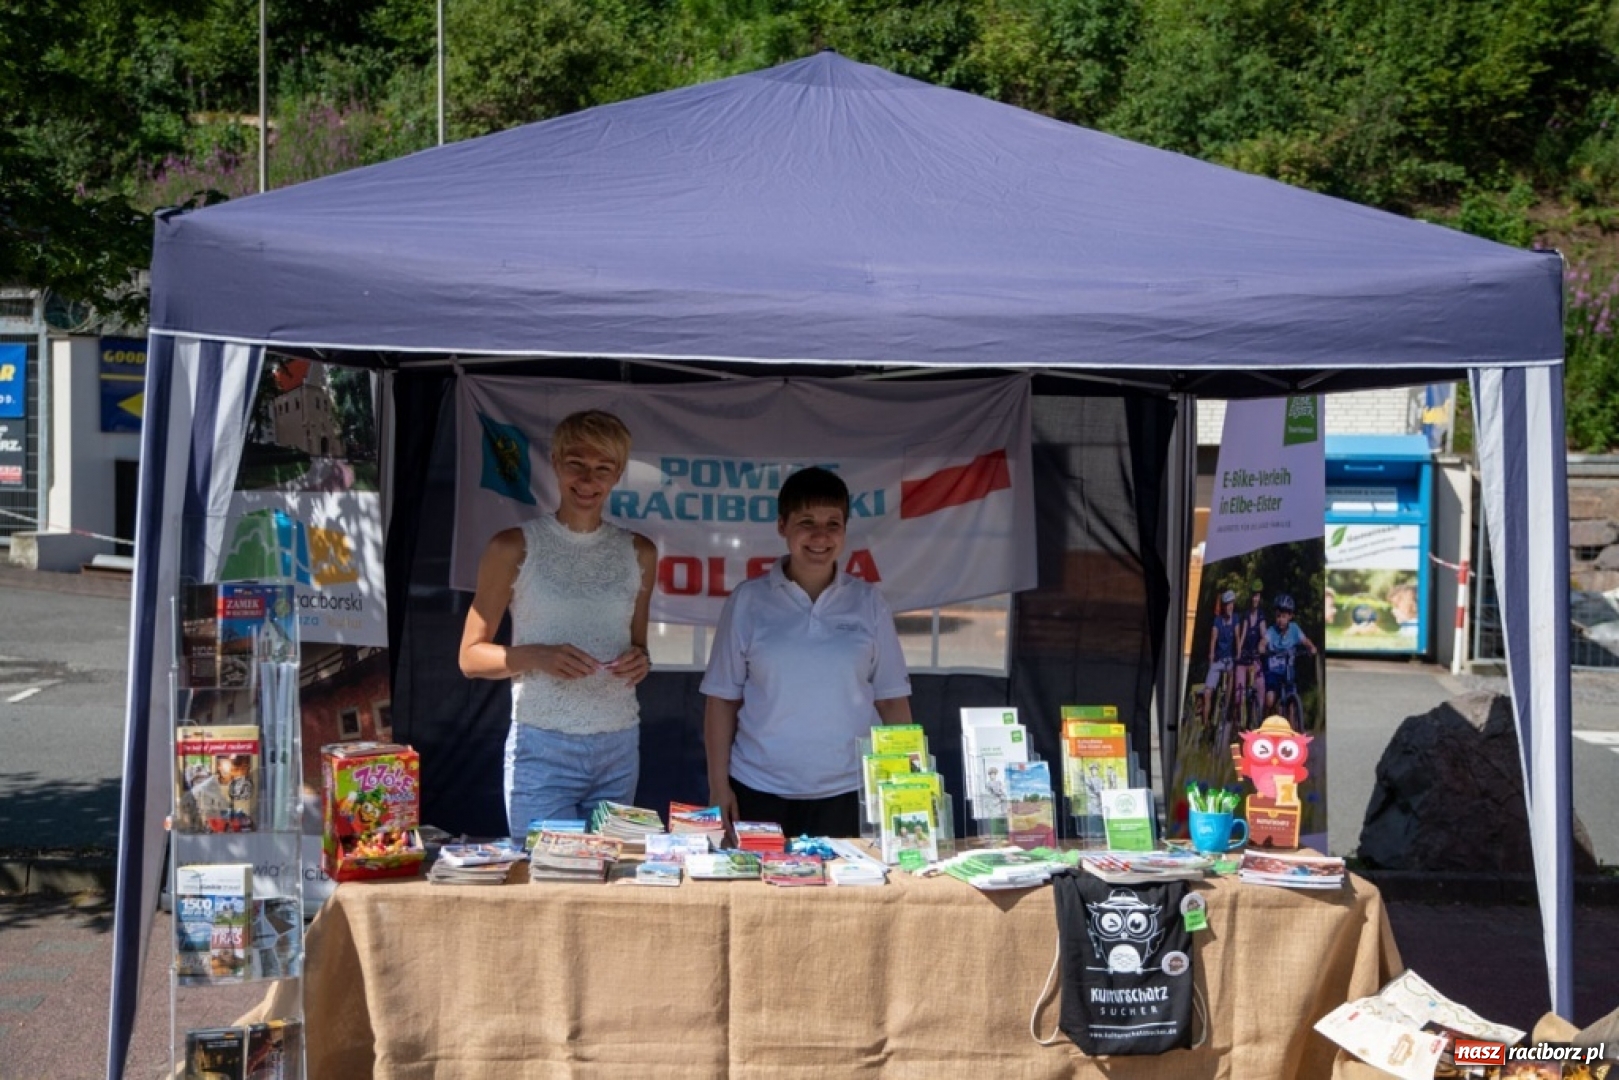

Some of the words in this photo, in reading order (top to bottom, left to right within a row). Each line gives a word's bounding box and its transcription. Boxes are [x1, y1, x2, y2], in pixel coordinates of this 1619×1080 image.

[103, 350, 146, 363] GOOD
[660, 456, 839, 490] POWI
[1223, 467, 1291, 488] E-Bike-Verleih
[610, 488, 885, 523] RACIBOKI
[1229, 494, 1282, 514] Elbe-Elster
[657, 548, 881, 597] OLA
[1100, 1005, 1158, 1016] SUCHER
